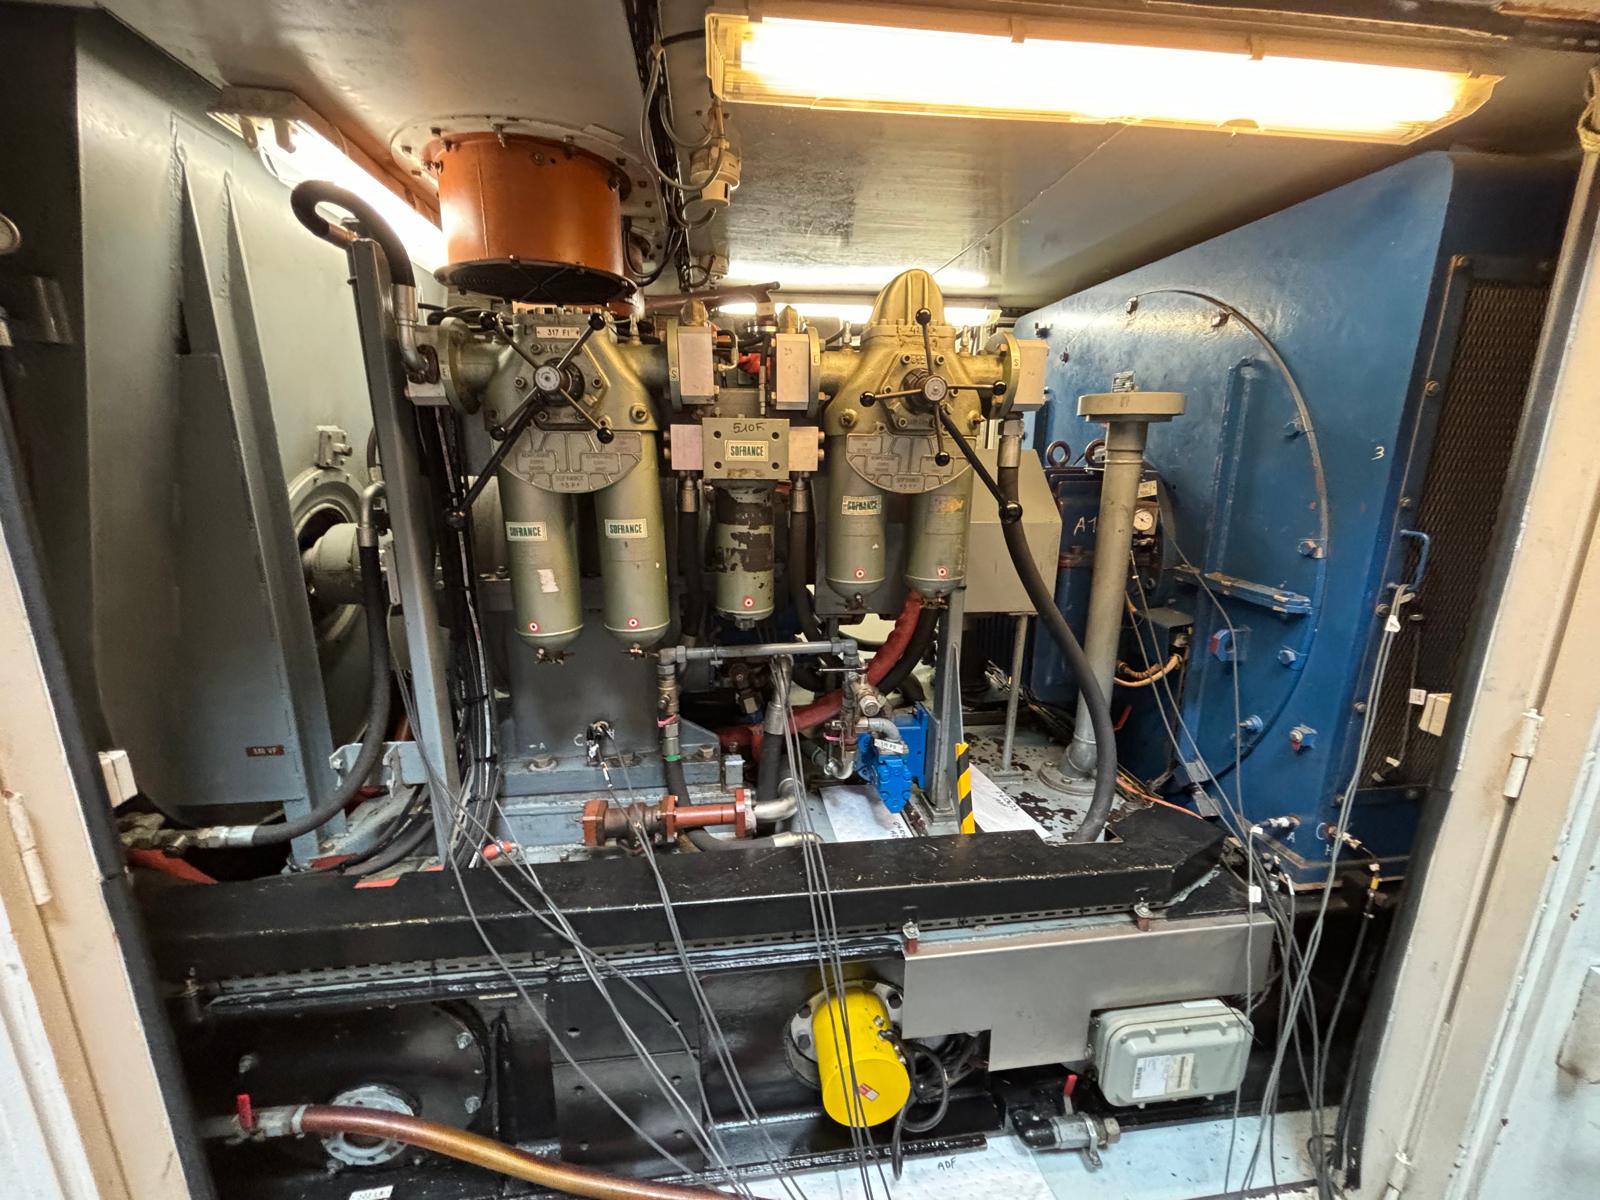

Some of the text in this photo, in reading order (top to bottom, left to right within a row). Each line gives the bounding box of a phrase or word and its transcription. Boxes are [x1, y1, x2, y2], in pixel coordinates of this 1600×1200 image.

[1013, 358, 1020, 367] S
[671, 369, 677, 379] S
[732, 422, 767, 434] 510F
[730, 446, 764, 457] SOFRANCE
[1371, 446, 1385, 461] 3
[509, 526, 542, 537] SOFRANCE
[609, 524, 643, 534] SOFRANCE
[937, 1156, 957, 1171] ADF
